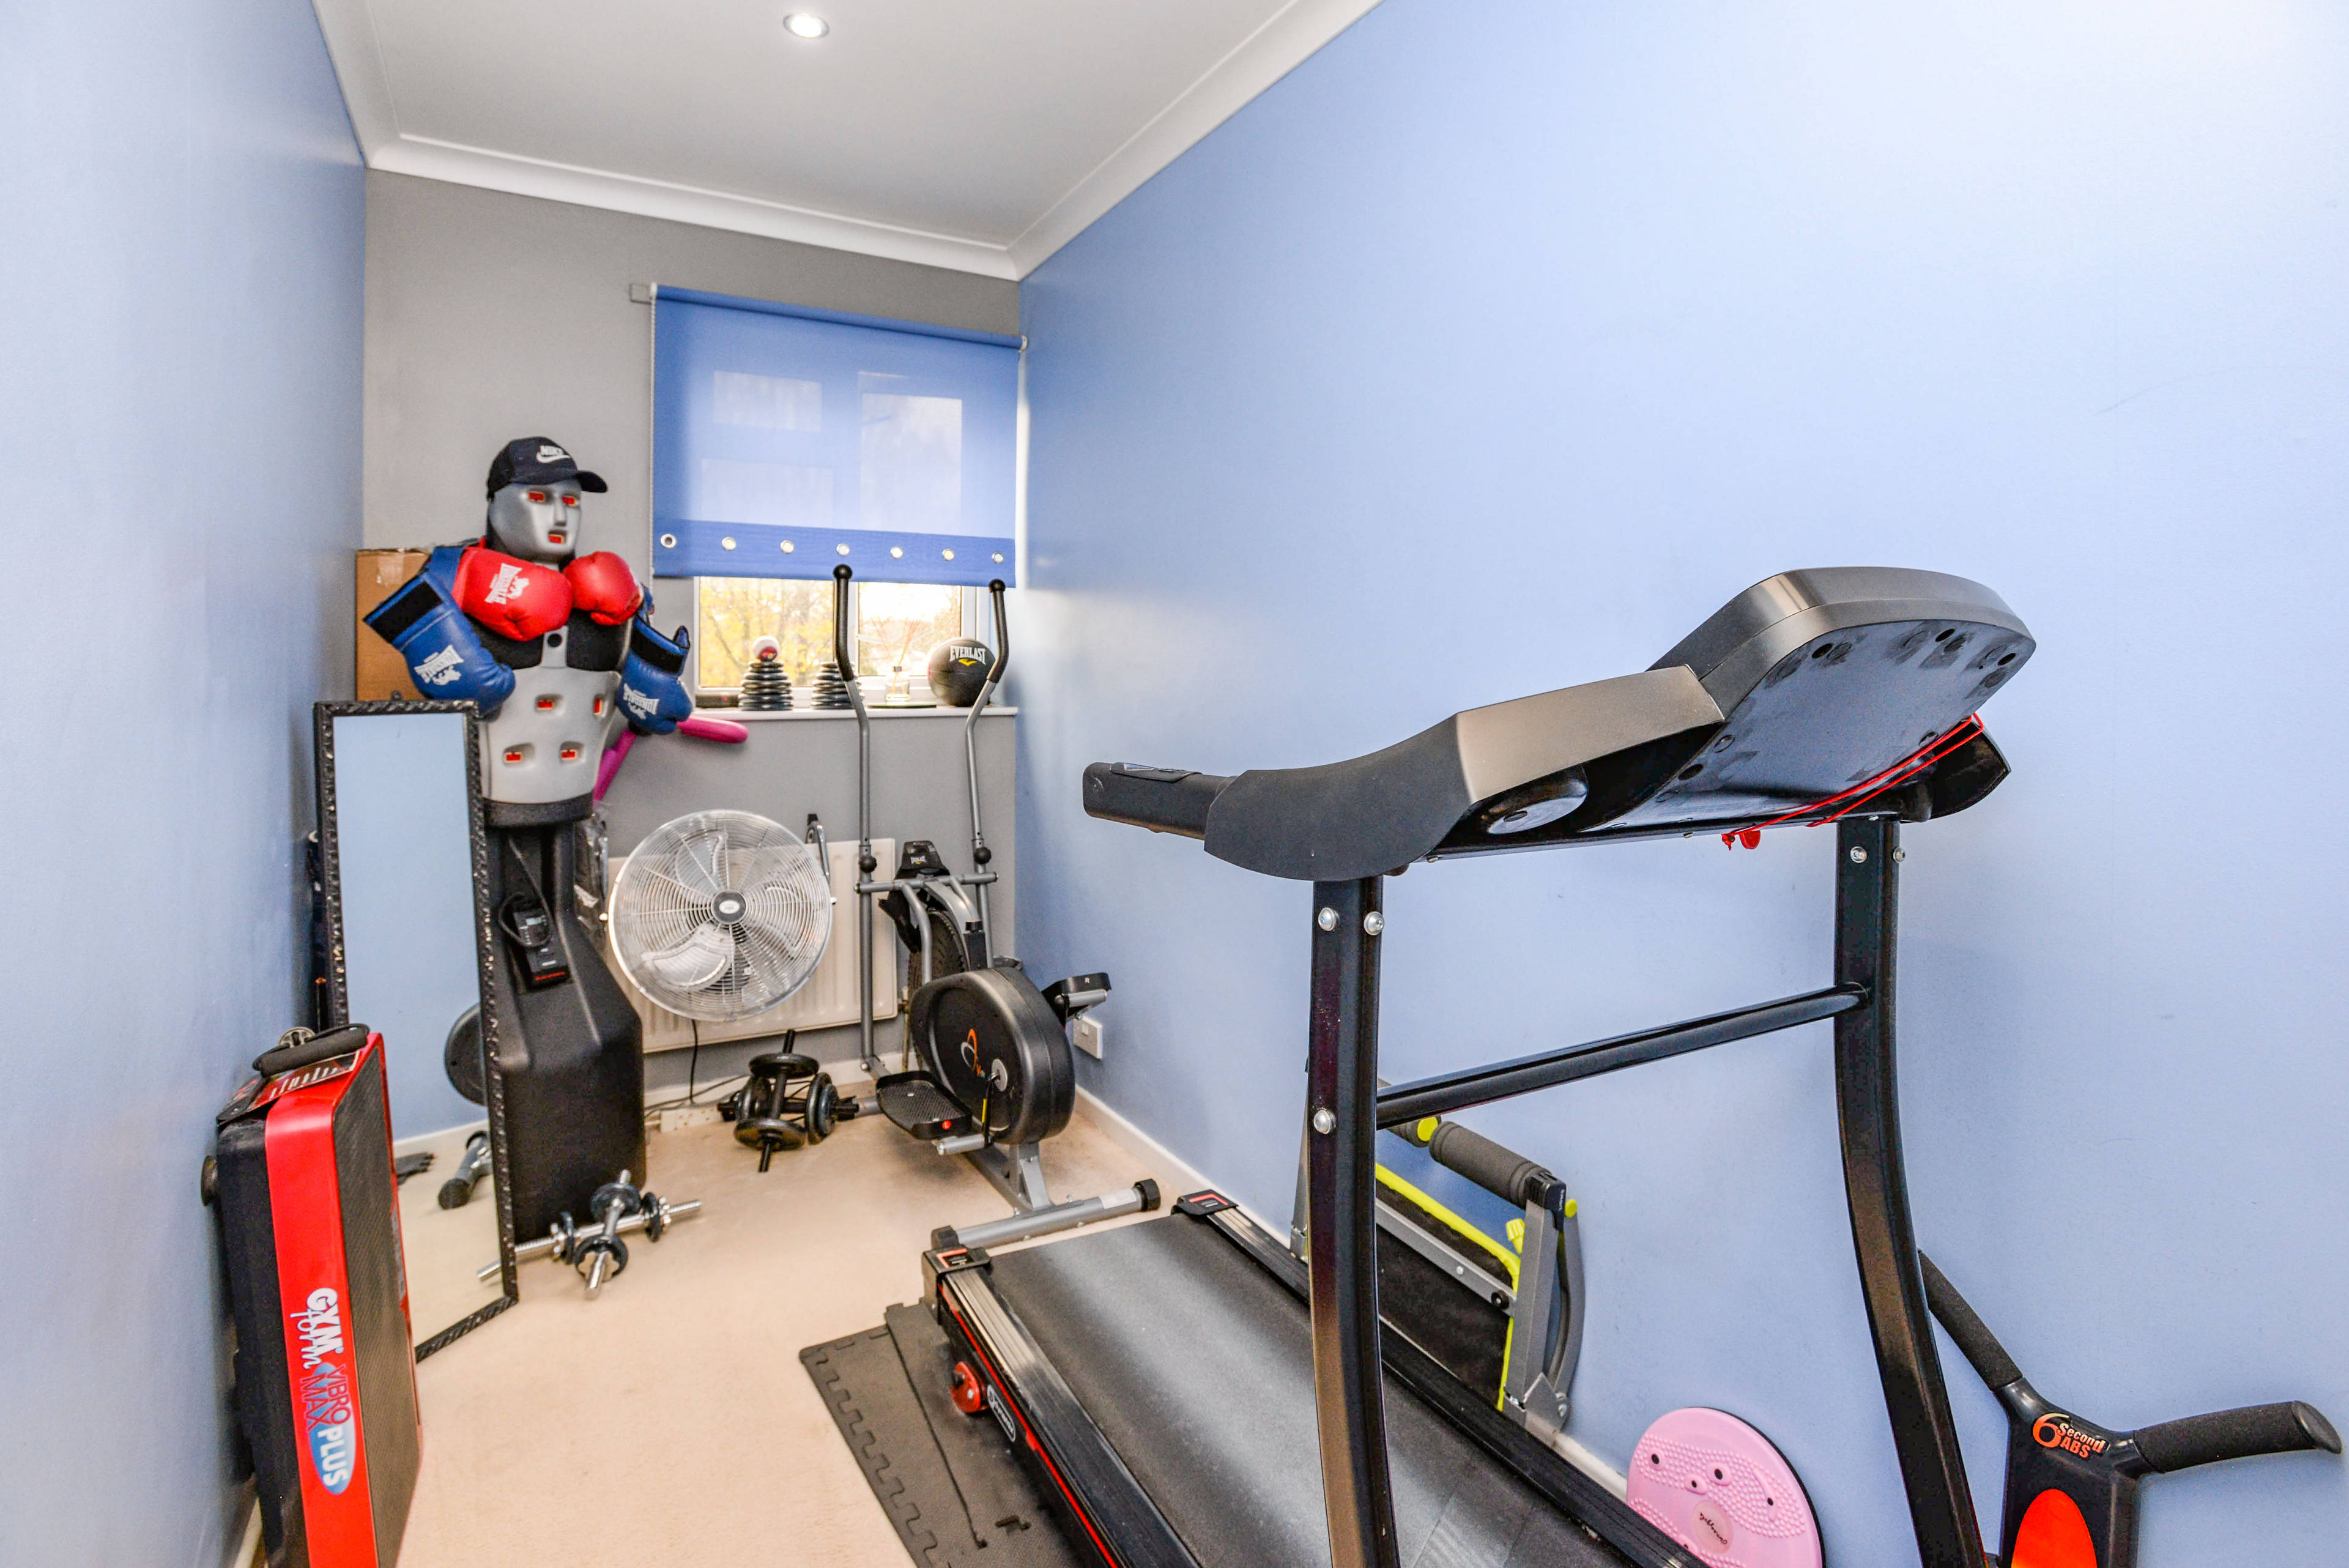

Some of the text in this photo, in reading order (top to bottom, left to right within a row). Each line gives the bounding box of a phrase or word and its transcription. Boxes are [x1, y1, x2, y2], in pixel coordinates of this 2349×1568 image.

[949, 645, 986, 664] EVERLAST
[306, 1288, 343, 1353] GYM
[301, 1373, 332, 1432] MAX
[327, 1364, 352, 1425] VIBRO
[317, 1425, 349, 1487] PLUS
[2032, 1412, 2106, 1453] 6 Second
[2060, 1436, 2091, 1458] ABS
